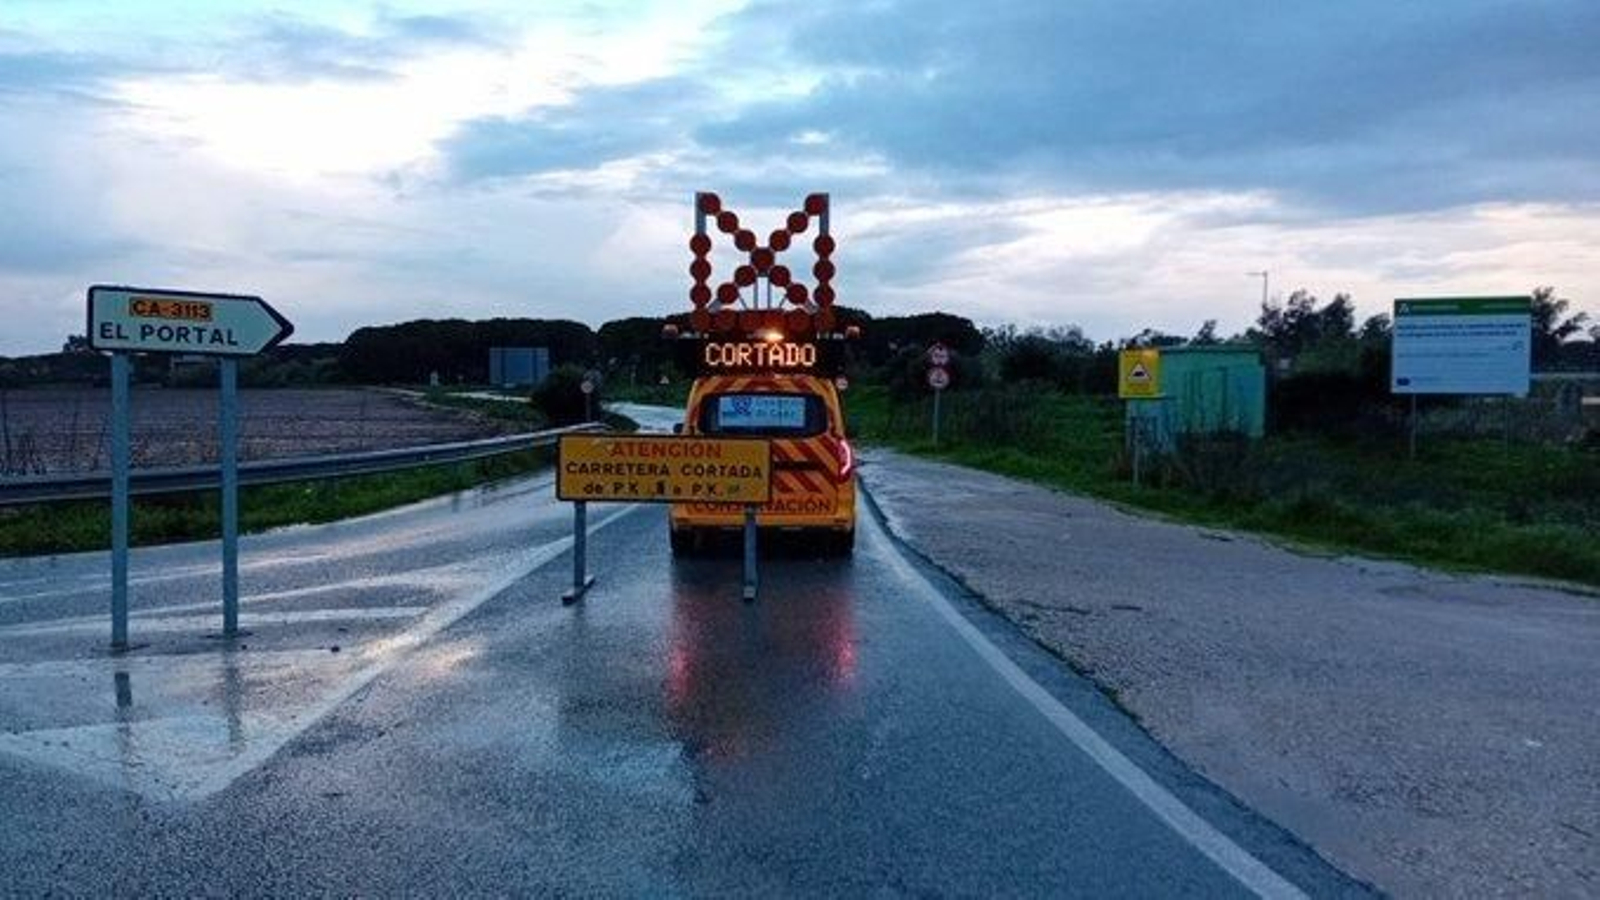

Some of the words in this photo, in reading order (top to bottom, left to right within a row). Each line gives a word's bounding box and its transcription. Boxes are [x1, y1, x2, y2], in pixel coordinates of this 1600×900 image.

[132, 300, 212, 319] CA-3113
[100, 322, 129, 340] EL
[140, 324, 238, 346] PORTAL
[705, 342, 816, 367] CORTADO
[565, 461, 670, 476] CARRETERA
[680, 463, 763, 479] CORTADA
[583, 481, 603, 494] de
